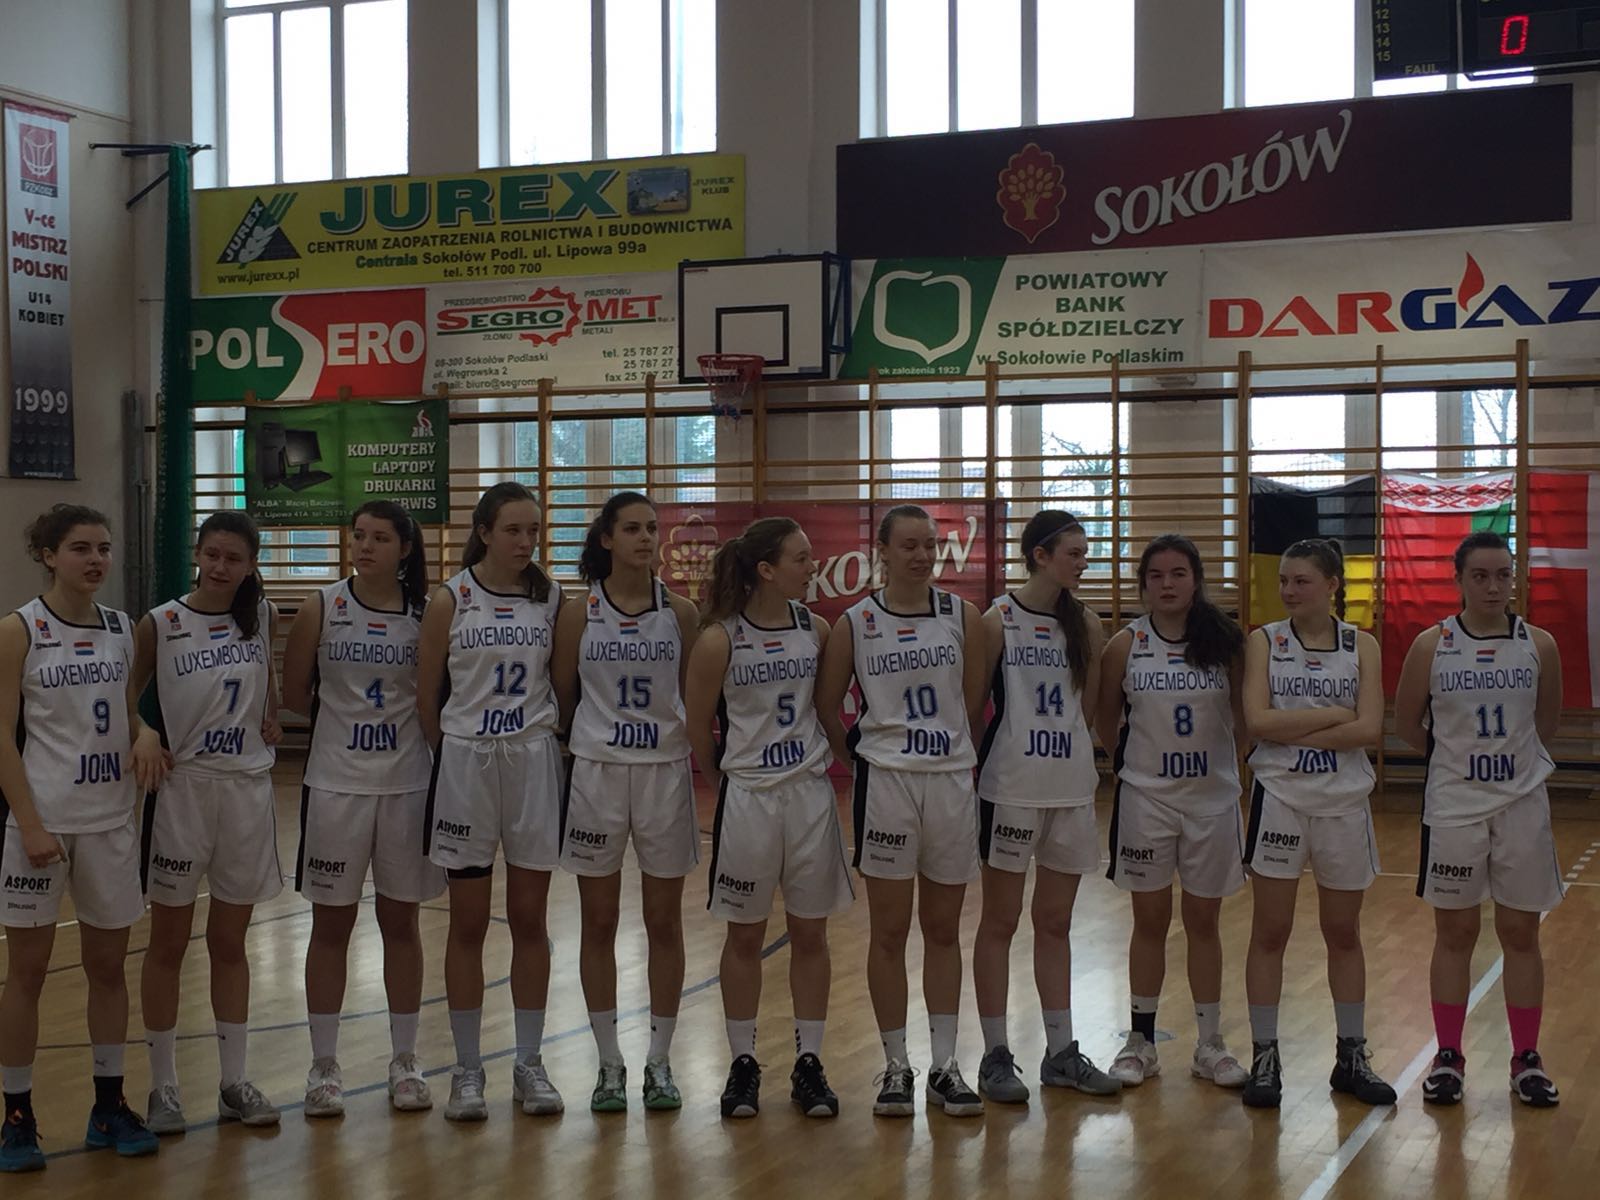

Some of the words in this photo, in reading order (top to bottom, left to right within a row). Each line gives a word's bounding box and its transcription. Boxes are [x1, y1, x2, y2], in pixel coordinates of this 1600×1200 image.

[1376, 8, 1390, 19] 12
[1376, 23, 1391, 34] 13
[1501, 15, 1529, 55] 0
[1376, 37, 1391, 48] 14
[1376, 51, 1392, 61] 15
[1405, 64, 1439, 75] FAUL
[1091, 109, 1353, 245] SOKOŁÓW
[319, 169, 621, 235] JUREX
[226, 203, 263, 261] JUREX
[307, 239, 377, 254] CENTRUM
[382, 231, 495, 250] ZAOPATRZENIA
[501, 226, 592, 243] ROLNICTWA
[608, 217, 733, 237] BUDOWNICTWA
[12, 231, 67, 255] MISTRZ
[356, 254, 418, 268] Centrala
[423, 249, 486, 264] Sokołów
[491, 247, 528, 261] Podl.
[533, 245, 551, 258] ul.
[557, 243, 613, 260] Lipowa
[618, 241, 647, 254] 99a
[12, 257, 68, 281] POLSKI
[217, 268, 300, 285] www.jurexx.pl
[444, 267, 462, 278] tel.
[467, 265, 488, 276] 511
[494, 264, 515, 275] 700
[520, 263, 542, 274] 700
[1016, 271, 1169, 290] POWIATOWY
[28, 291, 52, 305] U14
[1056, 296, 1126, 313] BANK
[1209, 277, 1600, 339] DARGAZ
[18, 309, 64, 327] KOBIET
[998, 317, 1185, 338] SPÓŁDZIELCZY
[465, 356, 504, 365] Sokołów
[507, 352, 549, 363] Podlaski
[602, 349, 619, 358] tel.
[623, 348, 636, 357] 25
[640, 347, 658, 356] 787
[662, 346, 674, 355] 27
[976, 354, 994, 366] w
[997, 351, 1086, 365] Sokołowie
[1092, 348, 1184, 364] Podlaskim
[447, 367, 499, 379] Węgrowska
[502, 367, 508, 375] 2
[624, 360, 637, 369] 25
[661, 358, 673, 367] 27
[938, 366, 961, 375] 1923
[605, 373, 621, 382] fax
[624, 372, 638, 381] 25
[662, 370, 674, 379] 27
[16, 387, 68, 414] 1999
[348, 442, 436, 457] KOMPUTERY
[373, 460, 436, 474] LAPTOPY
[364, 479, 436, 493] DRUKARKI
[388, 497, 437, 510] RWIS
[459, 626, 549, 649] LUXEMBOURG
[586, 641, 675, 661] LUXEMBOURG
[866, 645, 956, 676] LUXEMBOURG
[1005, 646, 1069, 668] LUXEMBOU
[39, 661, 123, 688] LUXEMBOUR
[492, 661, 528, 696] 12
[1132, 671, 1224, 691] LUXEMBOURG
[1440, 668, 1533, 692] LUXEMBOURG
[223, 678, 242, 715] 7
[365, 677, 385, 710] 4
[617, 674, 652, 710] 15
[1035, 681, 1064, 717] 14
[776, 692, 796, 728] 5
[903, 683, 938, 722] 10
[92, 698, 110, 736] 9
[1173, 703, 1194, 738] 8
[1476, 703, 1508, 739] 11
[569, 827, 608, 845] ASPORT
[866, 829, 907, 846] ASPORT
[995, 824, 1034, 841] ASPORT
[1261, 830, 1300, 847] ASPORT
[152, 854, 193, 873] ASPORT
[308, 856, 346, 873] ASPORT
[1431, 862, 1473, 877] ASPORT
[4, 874, 52, 890] ASPORT
[718, 873, 756, 893] ASPORT
